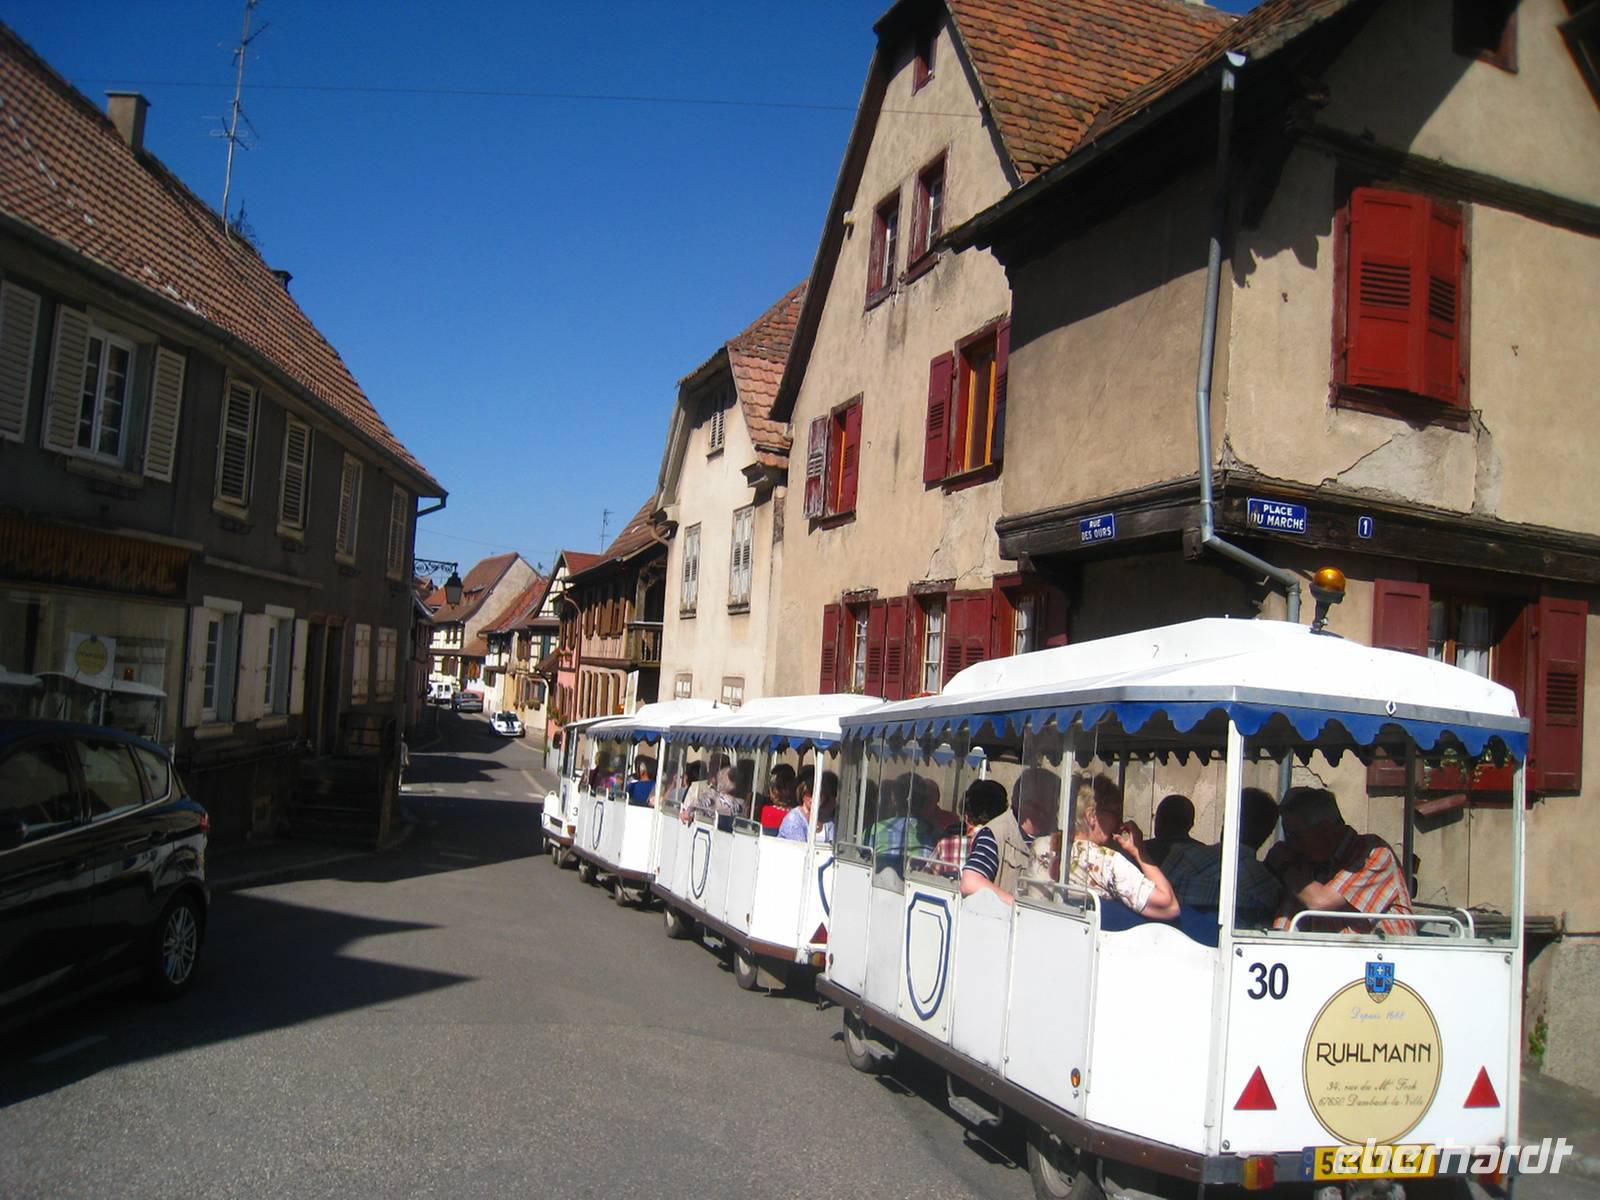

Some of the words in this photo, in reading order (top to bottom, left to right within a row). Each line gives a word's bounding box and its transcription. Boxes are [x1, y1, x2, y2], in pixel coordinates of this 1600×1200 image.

[1263, 504, 1293, 516] PLACE
[1250, 512, 1264, 524] DU
[1081, 530, 1092, 541] DES
[1094, 526, 1112, 538] OURS
[1363, 519, 1368, 535] 1
[1247, 962, 1289, 1000] 30
[1316, 1042, 1431, 1066] RUHLMANN
